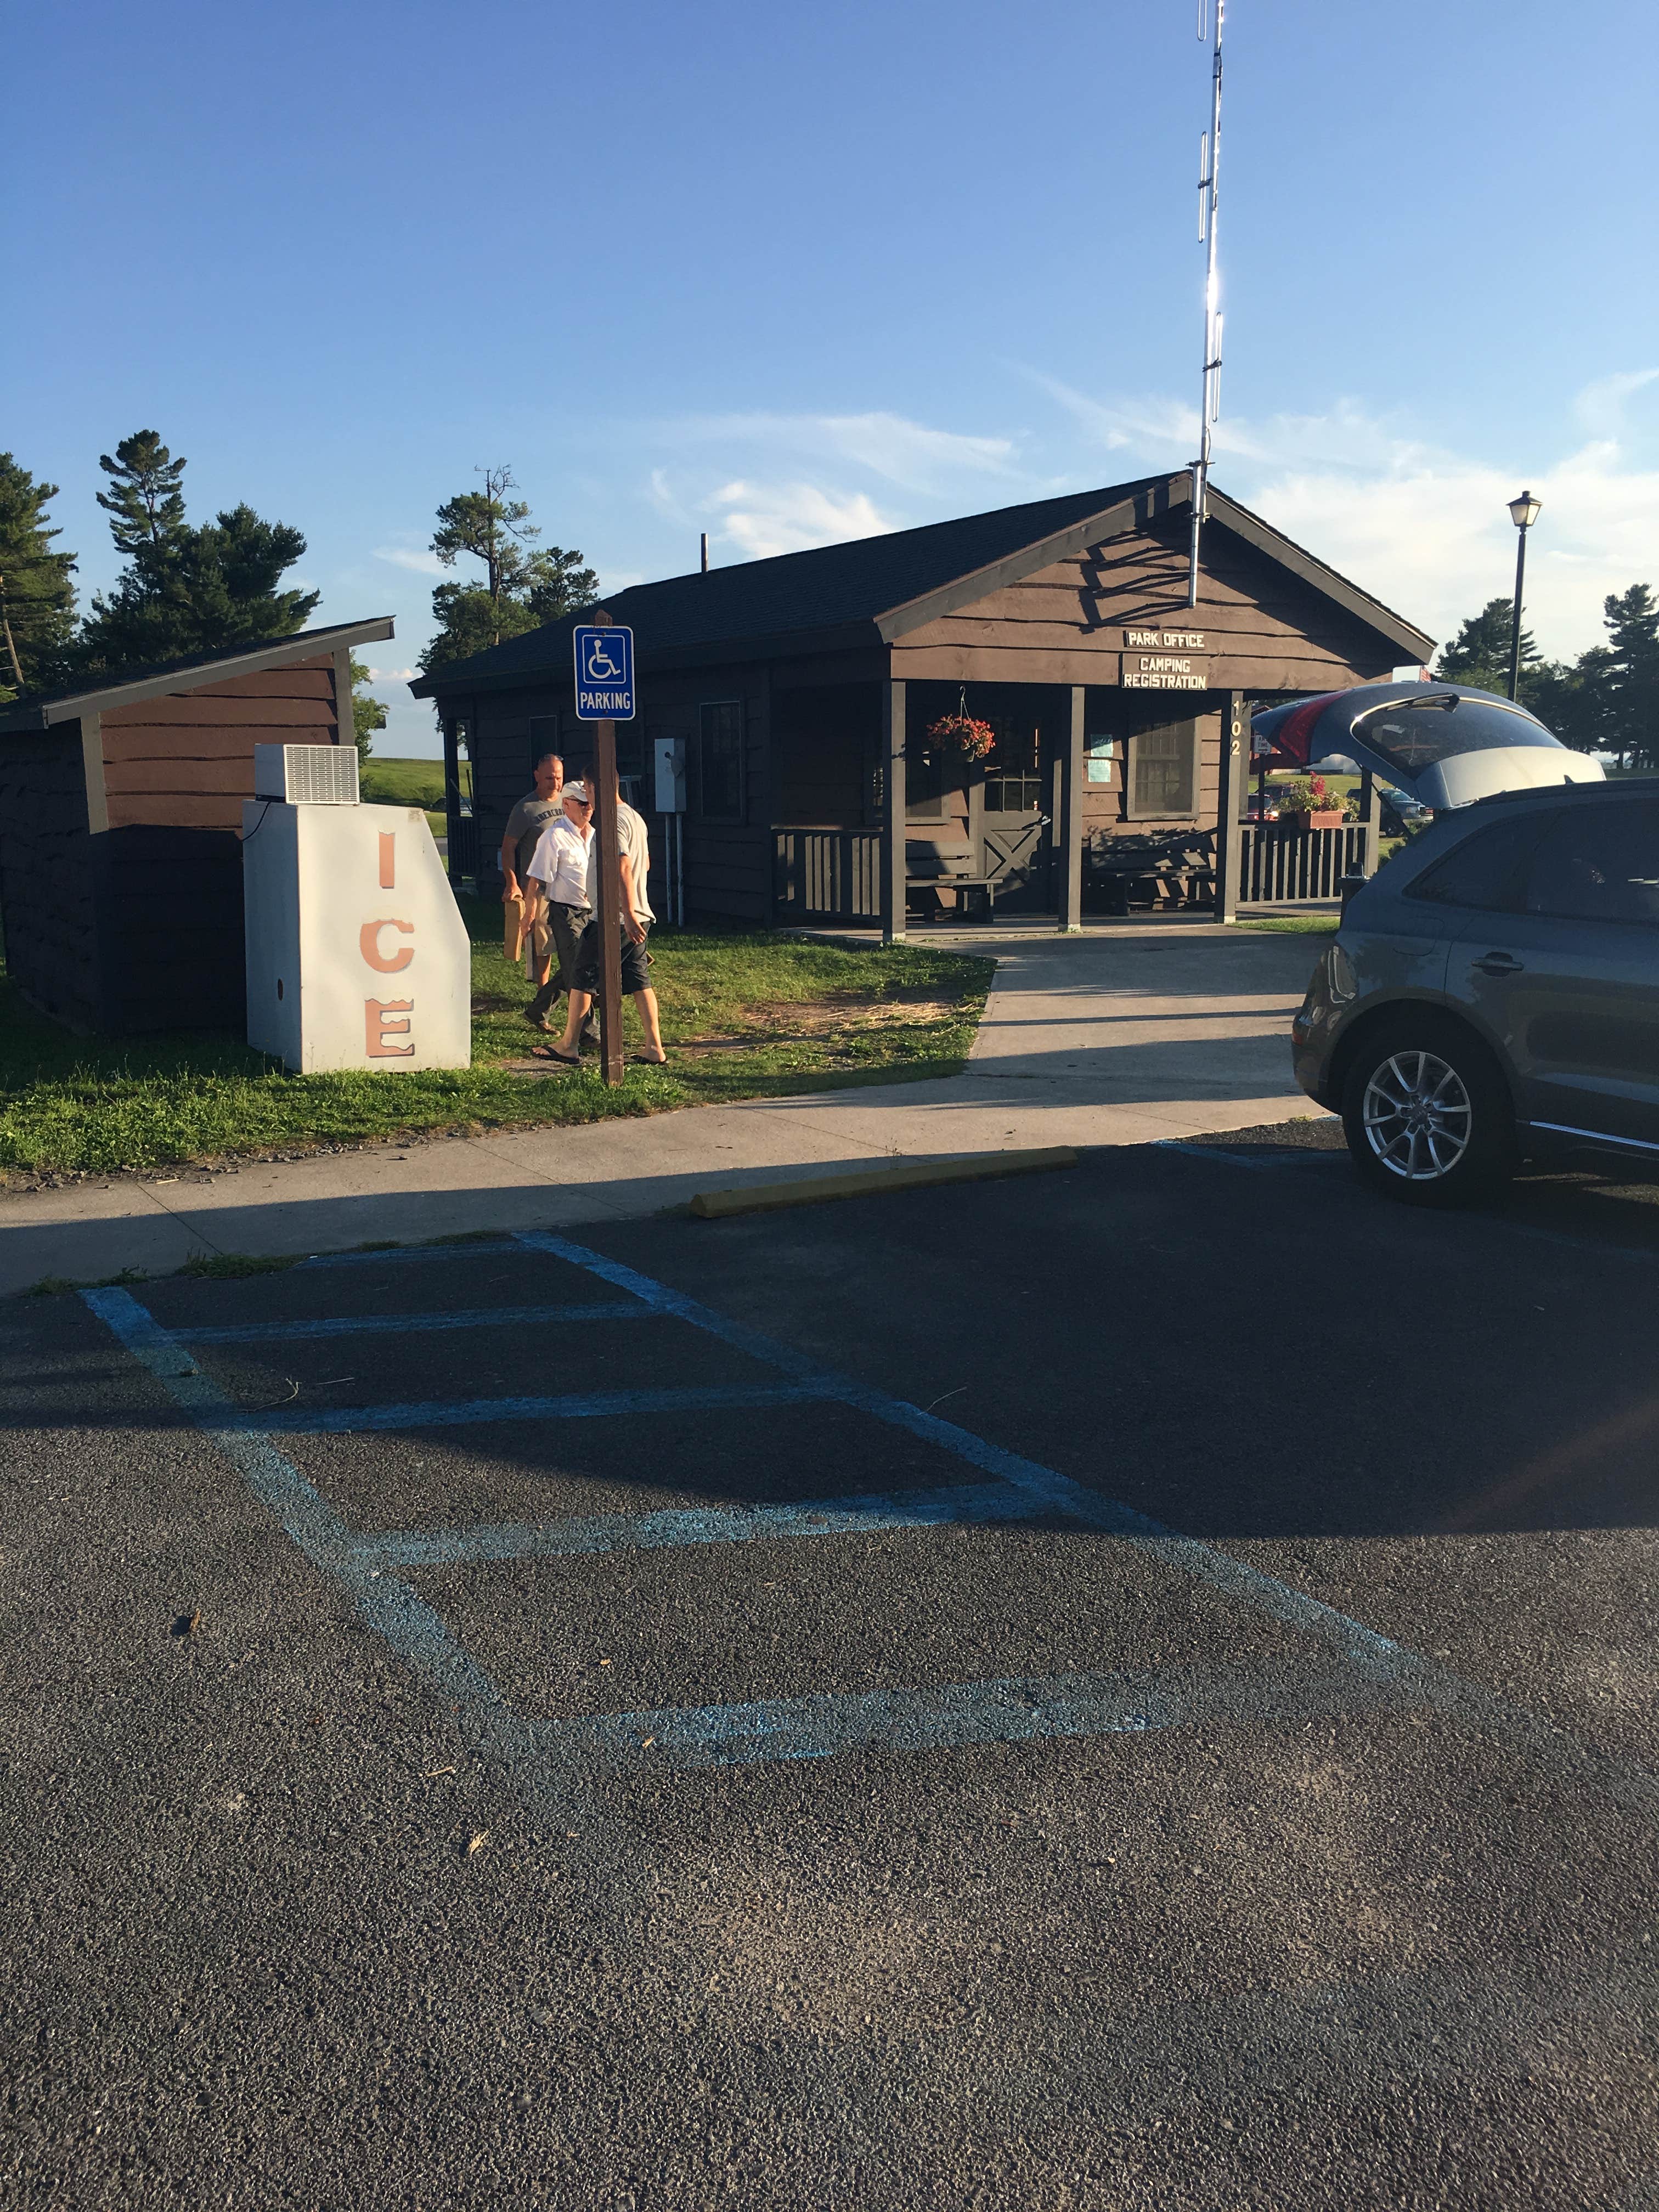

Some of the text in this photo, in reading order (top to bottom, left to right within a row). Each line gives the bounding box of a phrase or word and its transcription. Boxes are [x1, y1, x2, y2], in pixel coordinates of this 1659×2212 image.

[1128, 632, 1205, 647] PARK OFFICE
[1140, 658, 1190, 673] CAMPING
[1124, 674, 1206, 689] REGISTRATION
[580, 692, 631, 710] PARKING
[359, 829, 415, 1058] ICE
